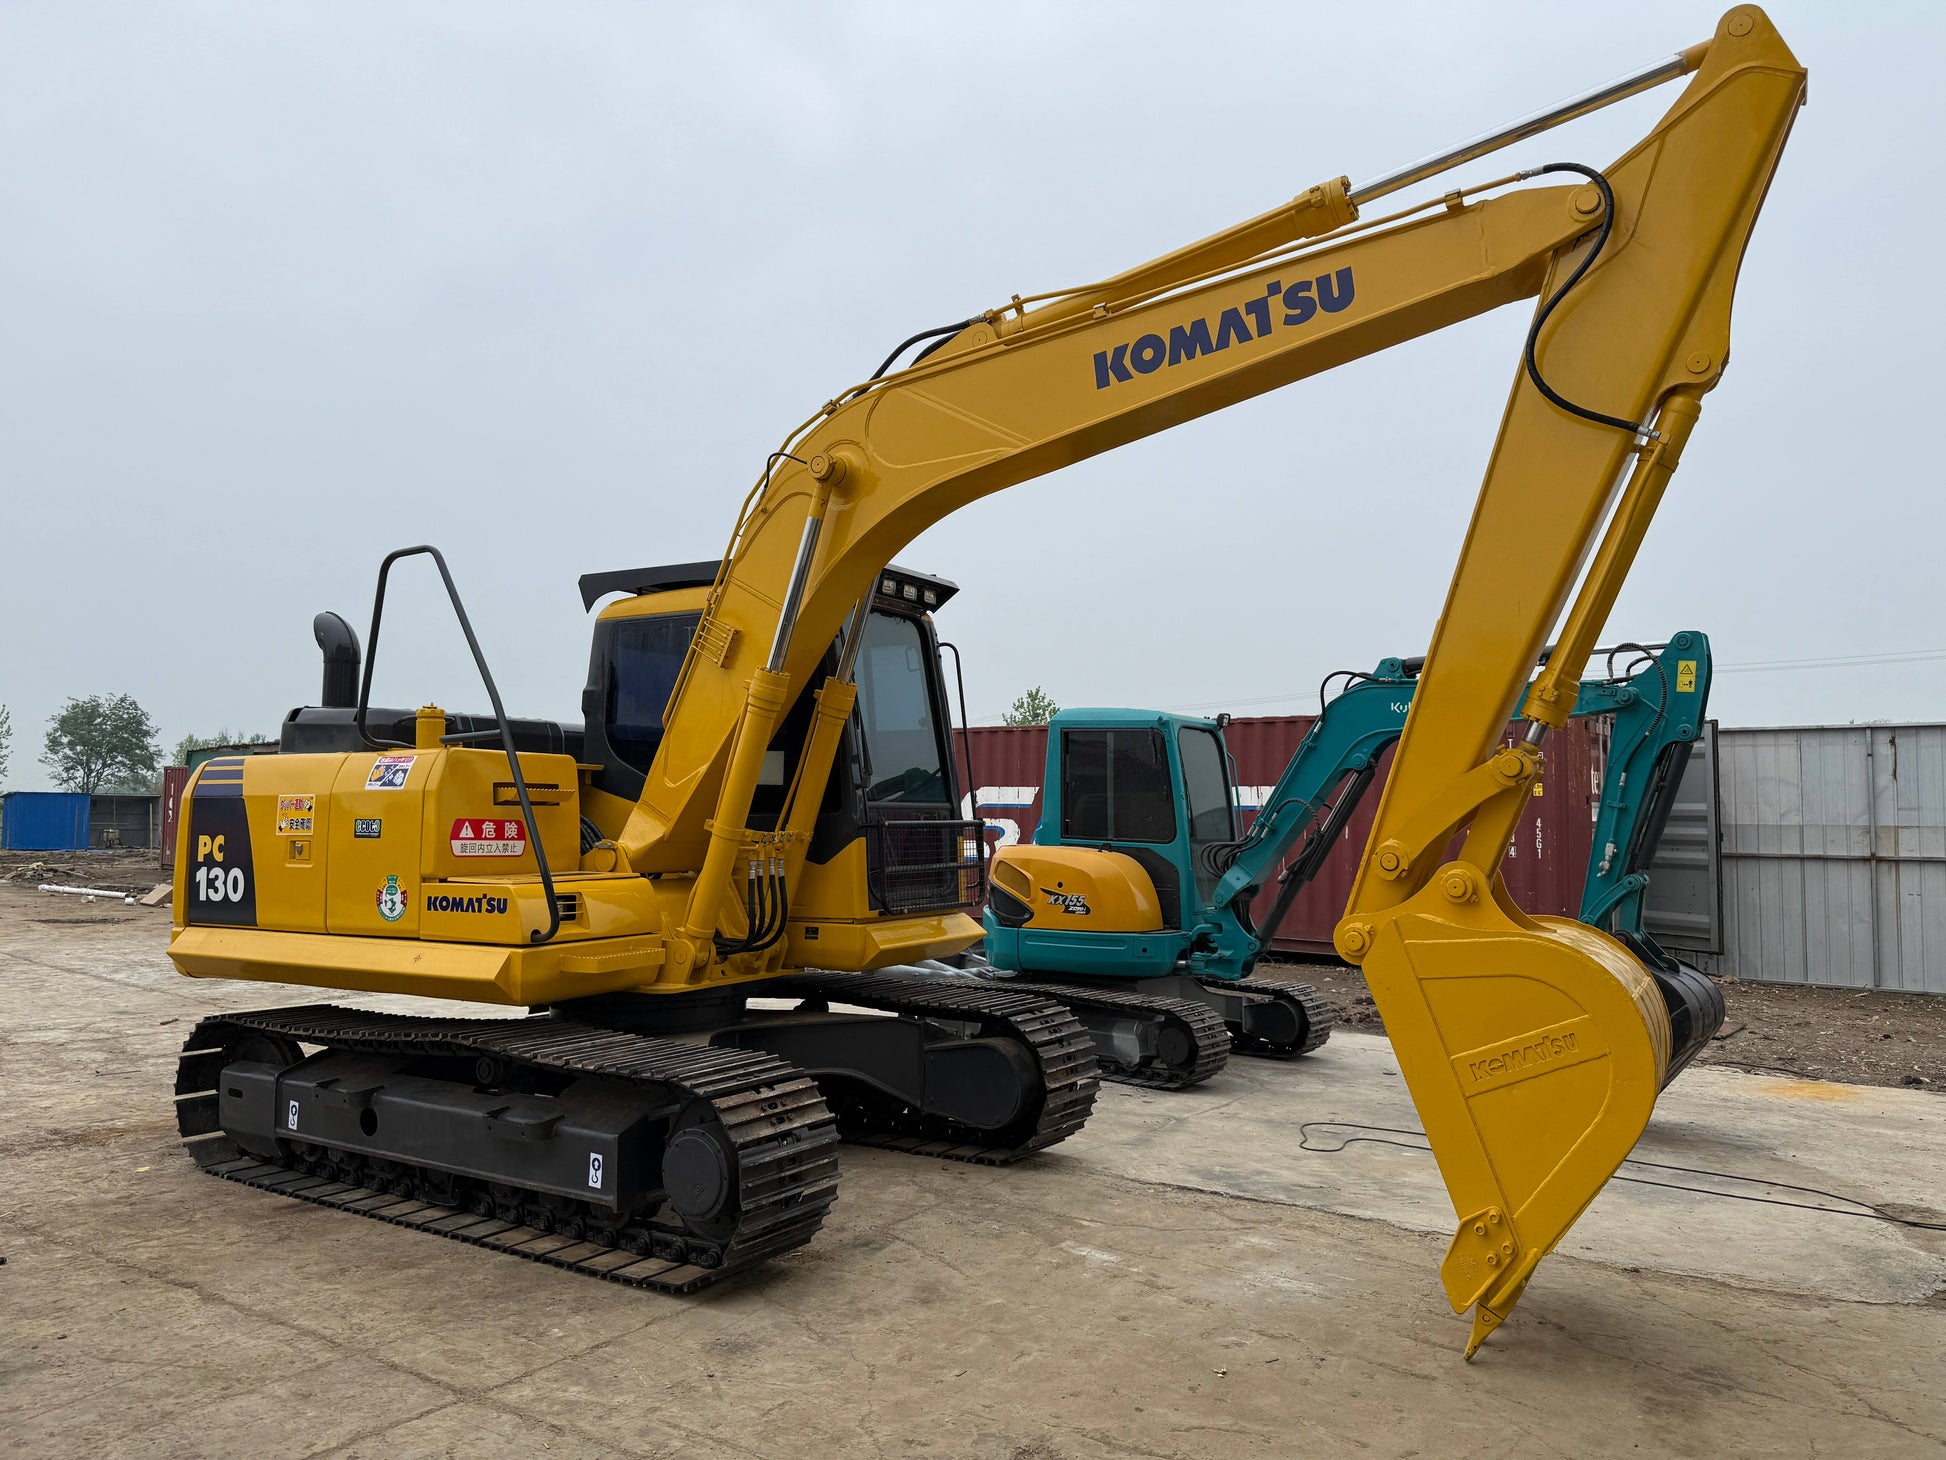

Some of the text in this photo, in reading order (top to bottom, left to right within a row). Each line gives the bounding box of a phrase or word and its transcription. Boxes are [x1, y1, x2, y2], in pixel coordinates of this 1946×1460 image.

[1093, 266, 1355, 390] KOMATSU
[481, 821, 518, 839] 危険
[197, 834, 225, 862] PC
[195, 866, 245, 903] 130
[427, 893, 508, 914] KOMATSU
[1048, 895, 1087, 906] KX155
[1469, 1032, 1579, 1082] KOMATSU
